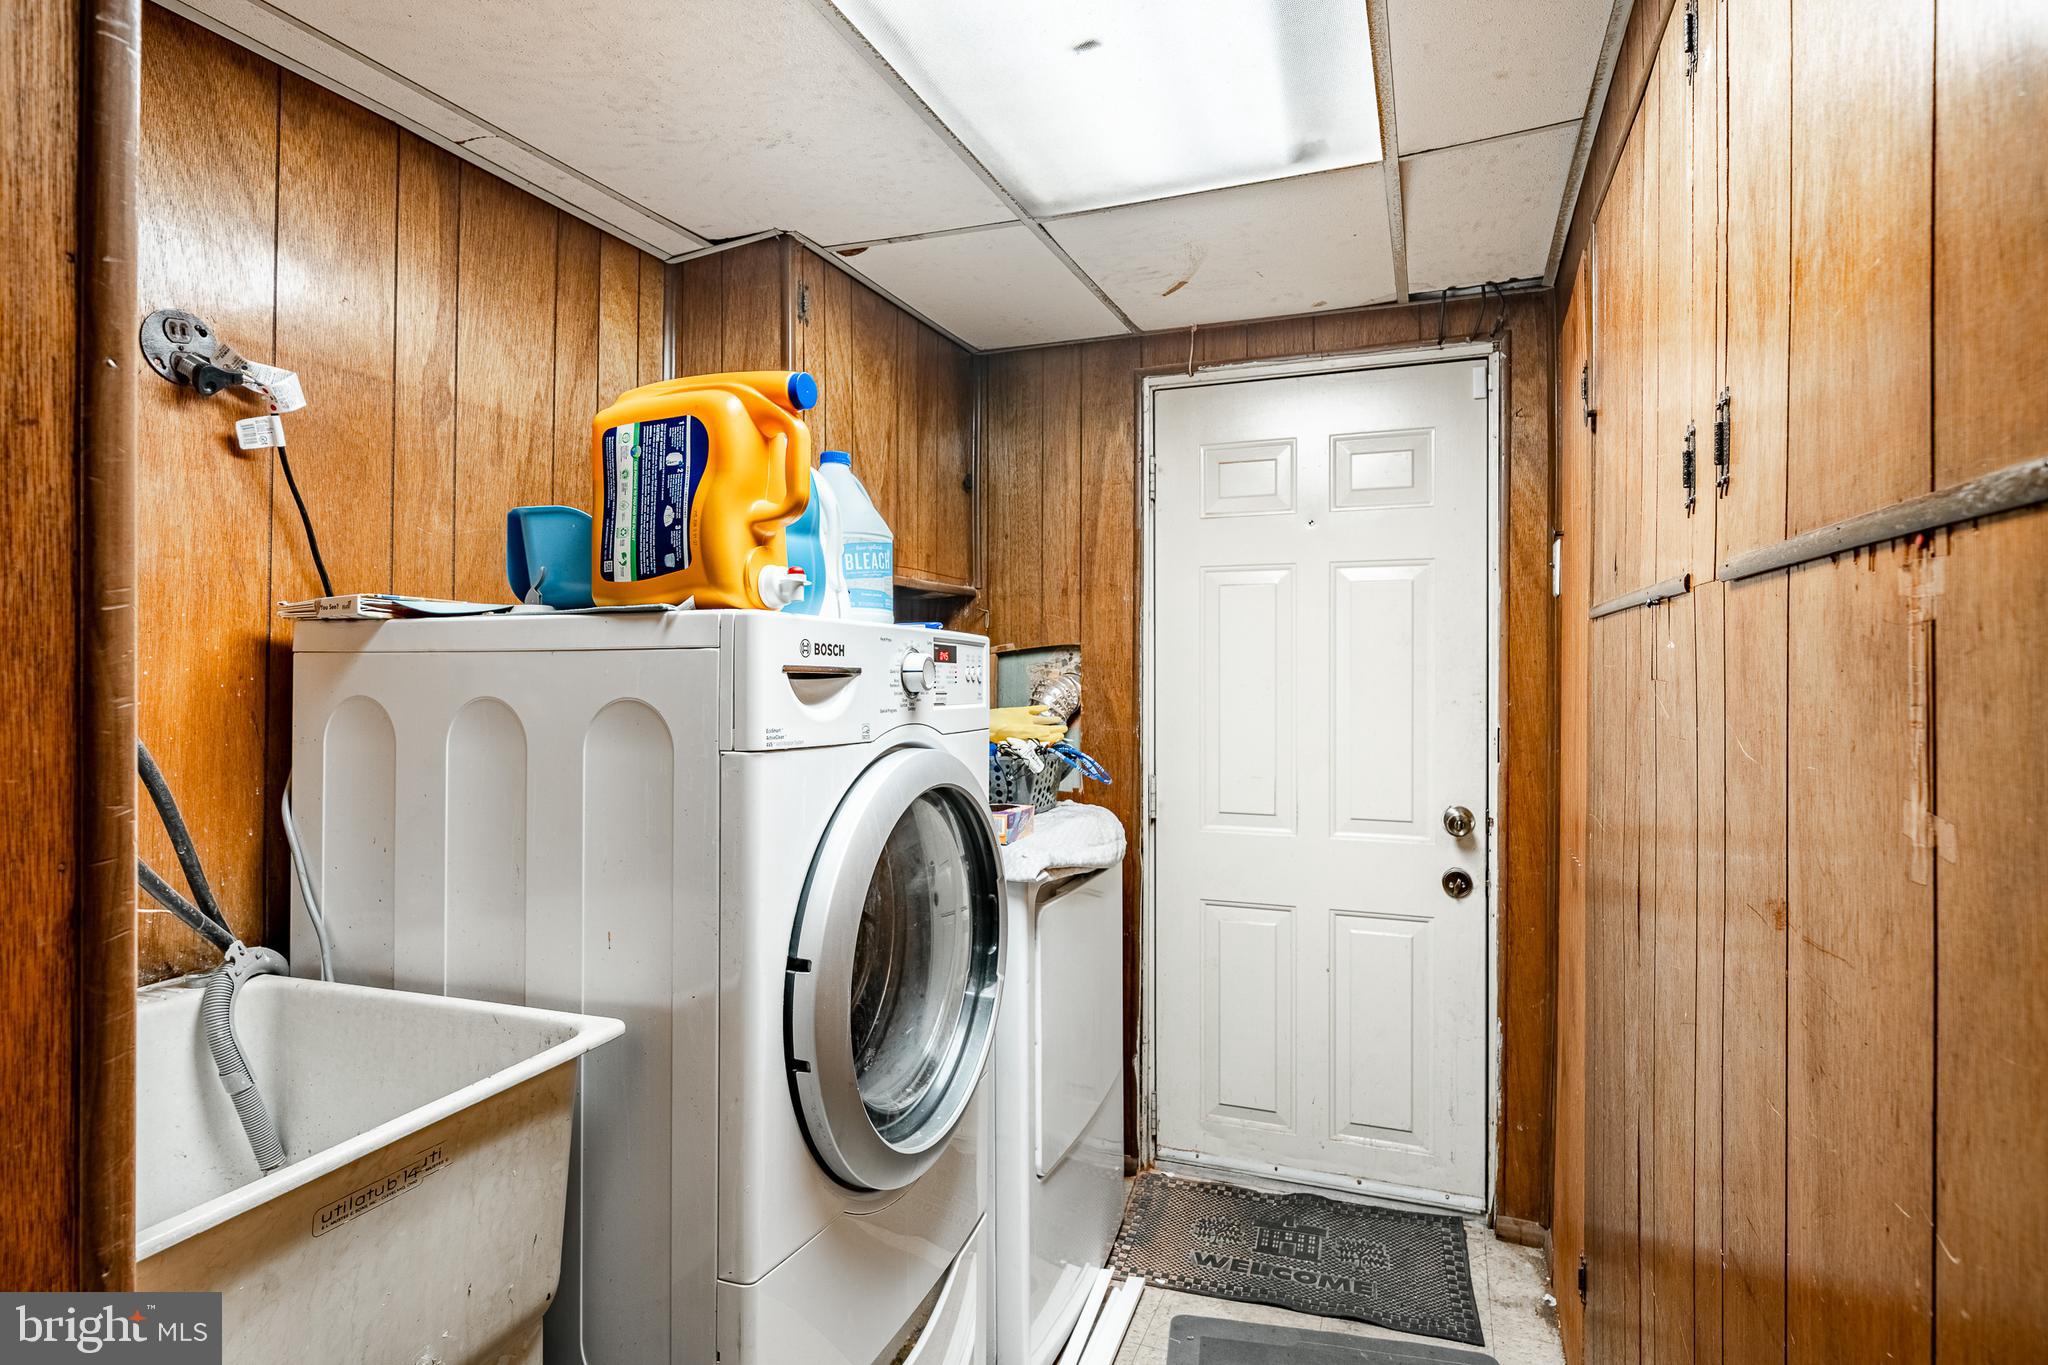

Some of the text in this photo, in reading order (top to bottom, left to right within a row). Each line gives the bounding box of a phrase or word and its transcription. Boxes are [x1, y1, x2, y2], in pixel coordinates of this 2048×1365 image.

[844, 551, 890, 570] BLEACH
[814, 642, 845, 657] BOSCH
[321, 1178, 397, 1223] utilatub
[1193, 1252, 1377, 1297] WELCOME
